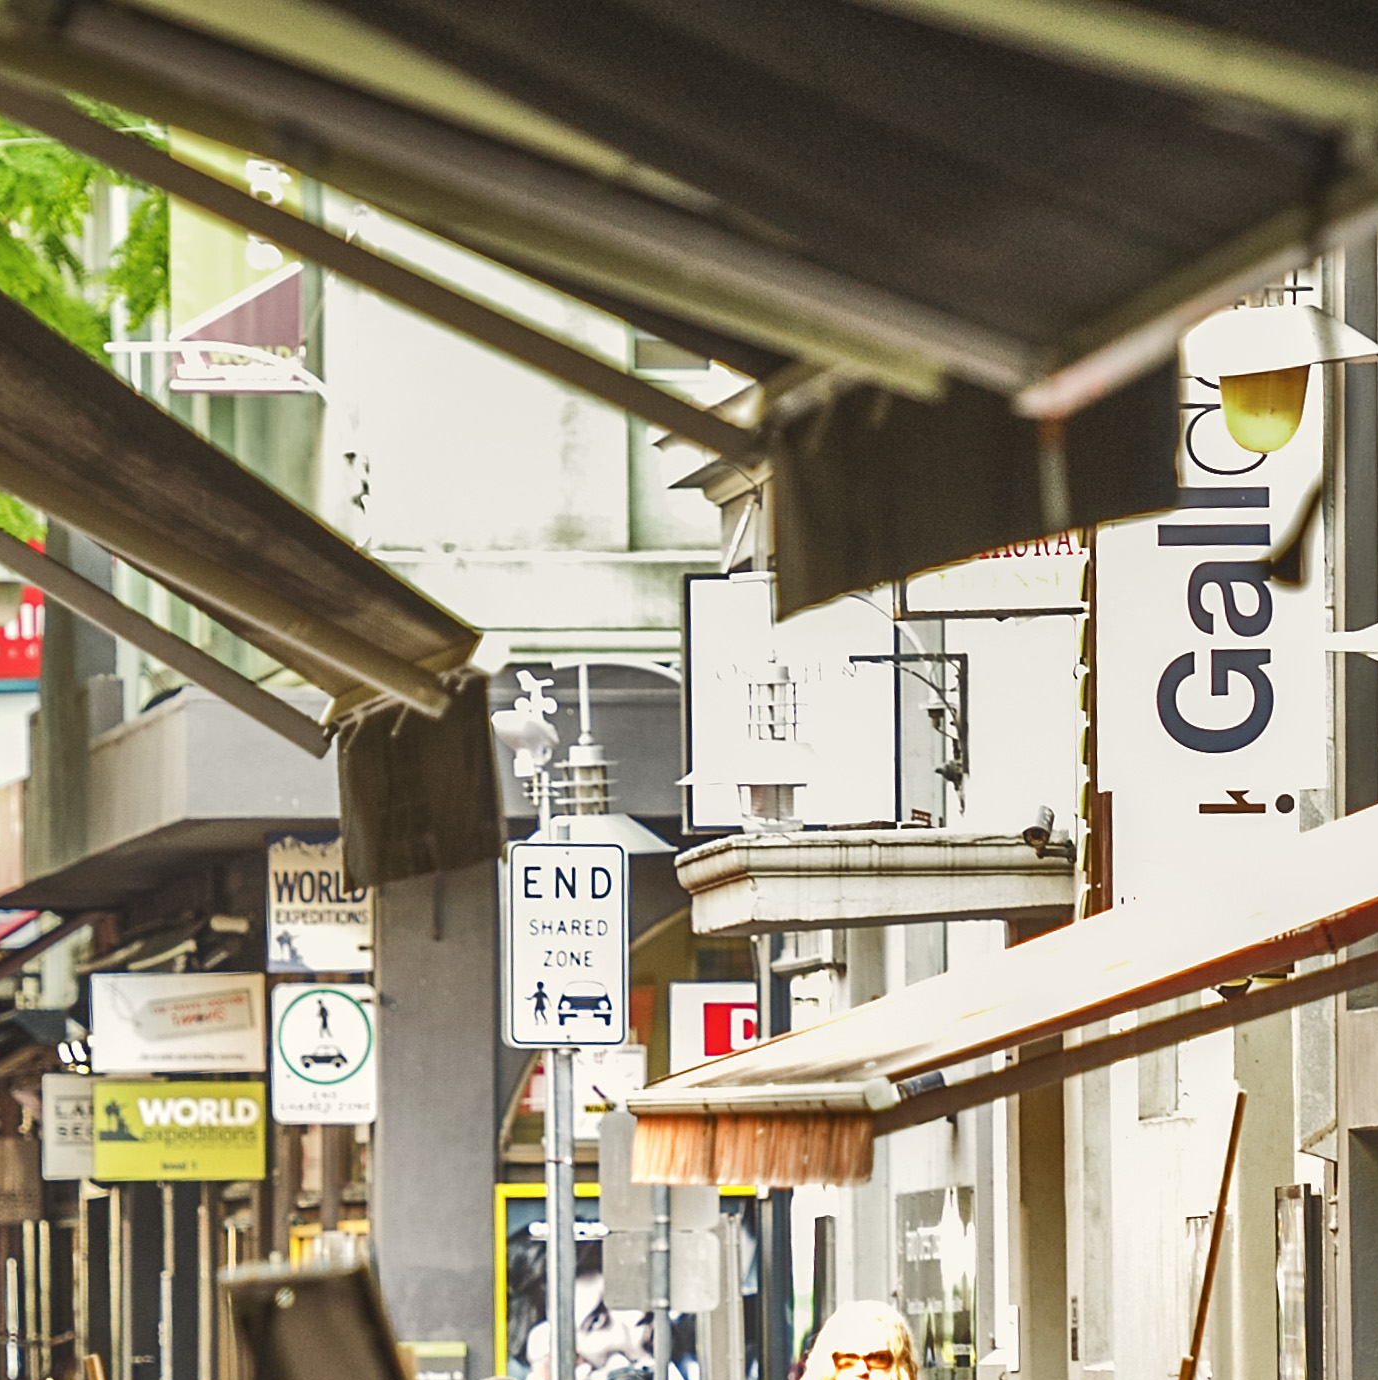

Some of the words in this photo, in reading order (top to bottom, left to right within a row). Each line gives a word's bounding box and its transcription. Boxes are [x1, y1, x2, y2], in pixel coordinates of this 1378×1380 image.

[524, 866, 612, 899] END
[275, 910, 368, 925] EXPEDITIONS
[529, 919, 608, 936] SHARED
[543, 950, 593, 968] ZONE
[137, 1097, 260, 1127] WORLD
[142, 1126, 257, 1147] expeditions
